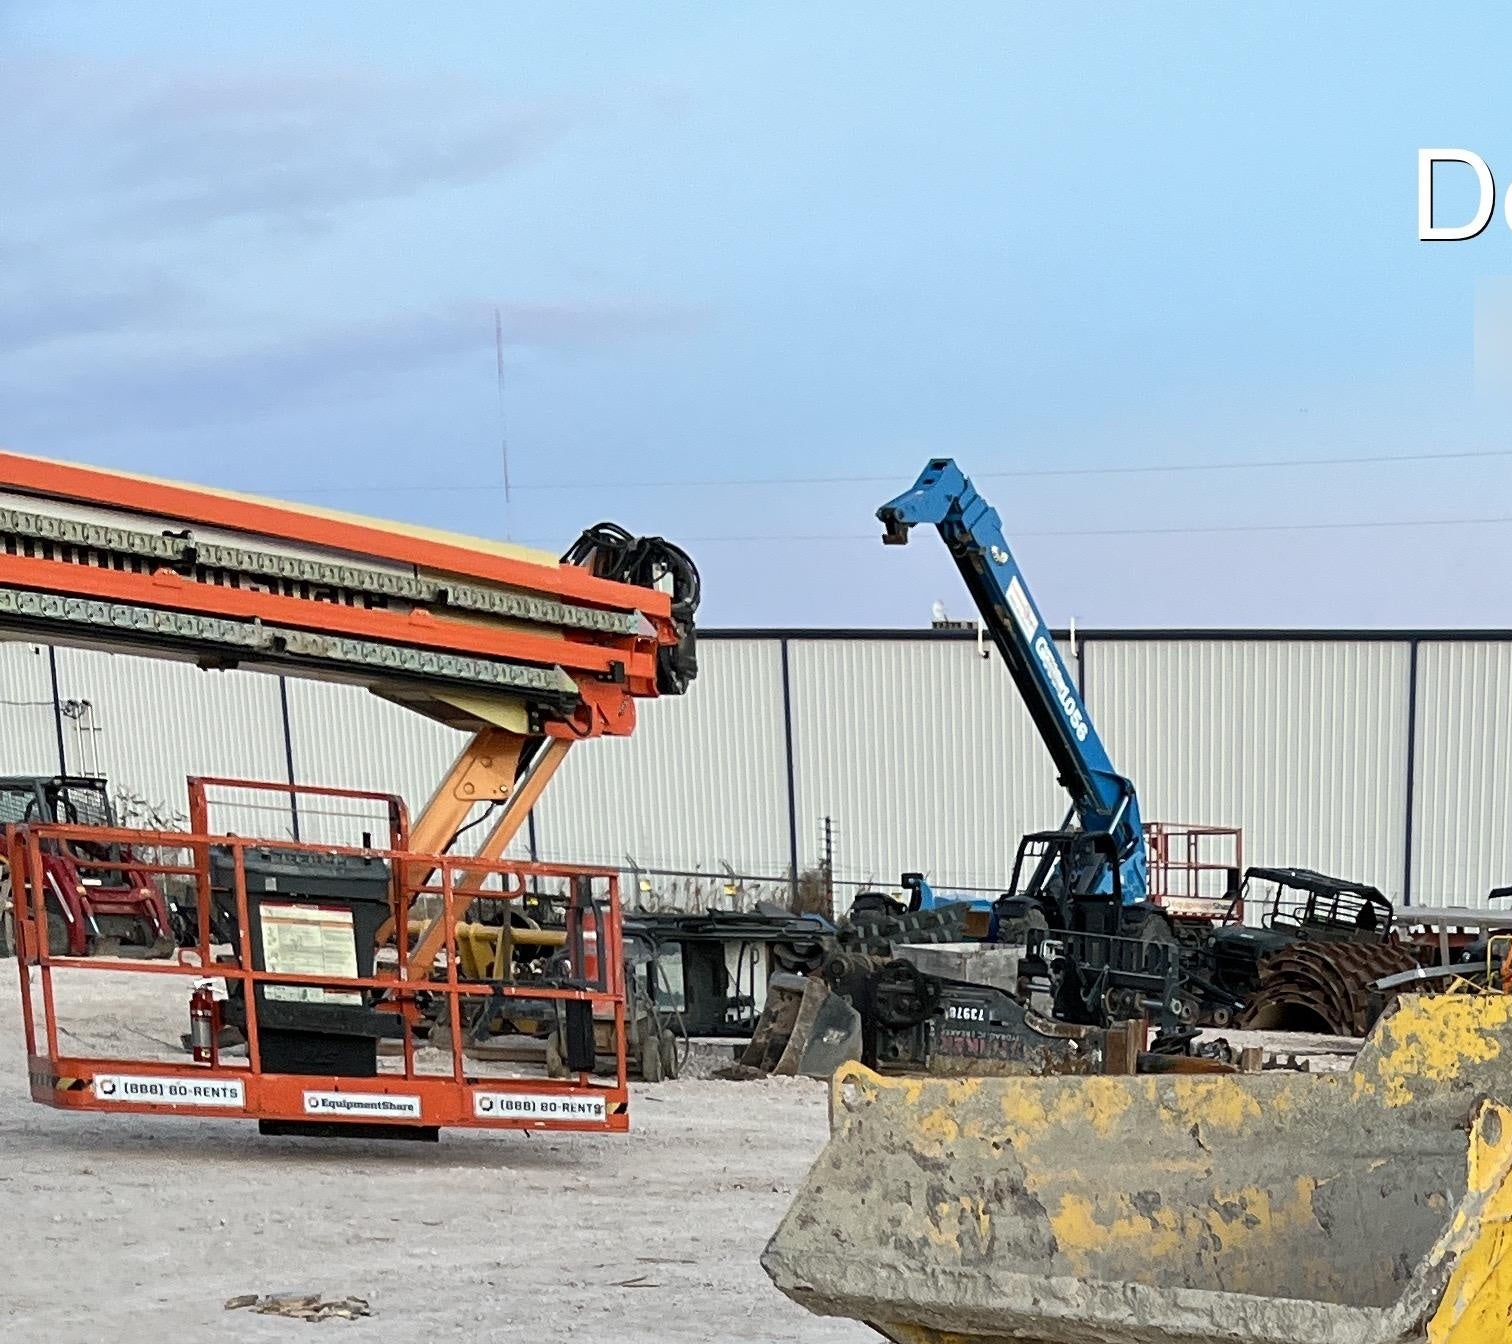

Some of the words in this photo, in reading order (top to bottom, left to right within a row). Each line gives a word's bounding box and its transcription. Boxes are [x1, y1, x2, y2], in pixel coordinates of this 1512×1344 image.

[124, 1082, 164, 1096] (888)
[169, 1085, 238, 1099] 80-RENTS
[321, 1097, 414, 1112] EquipmentShare
[500, 1099, 536, 1112] (888)
[540, 1102, 602, 1115] 80-RENTS
